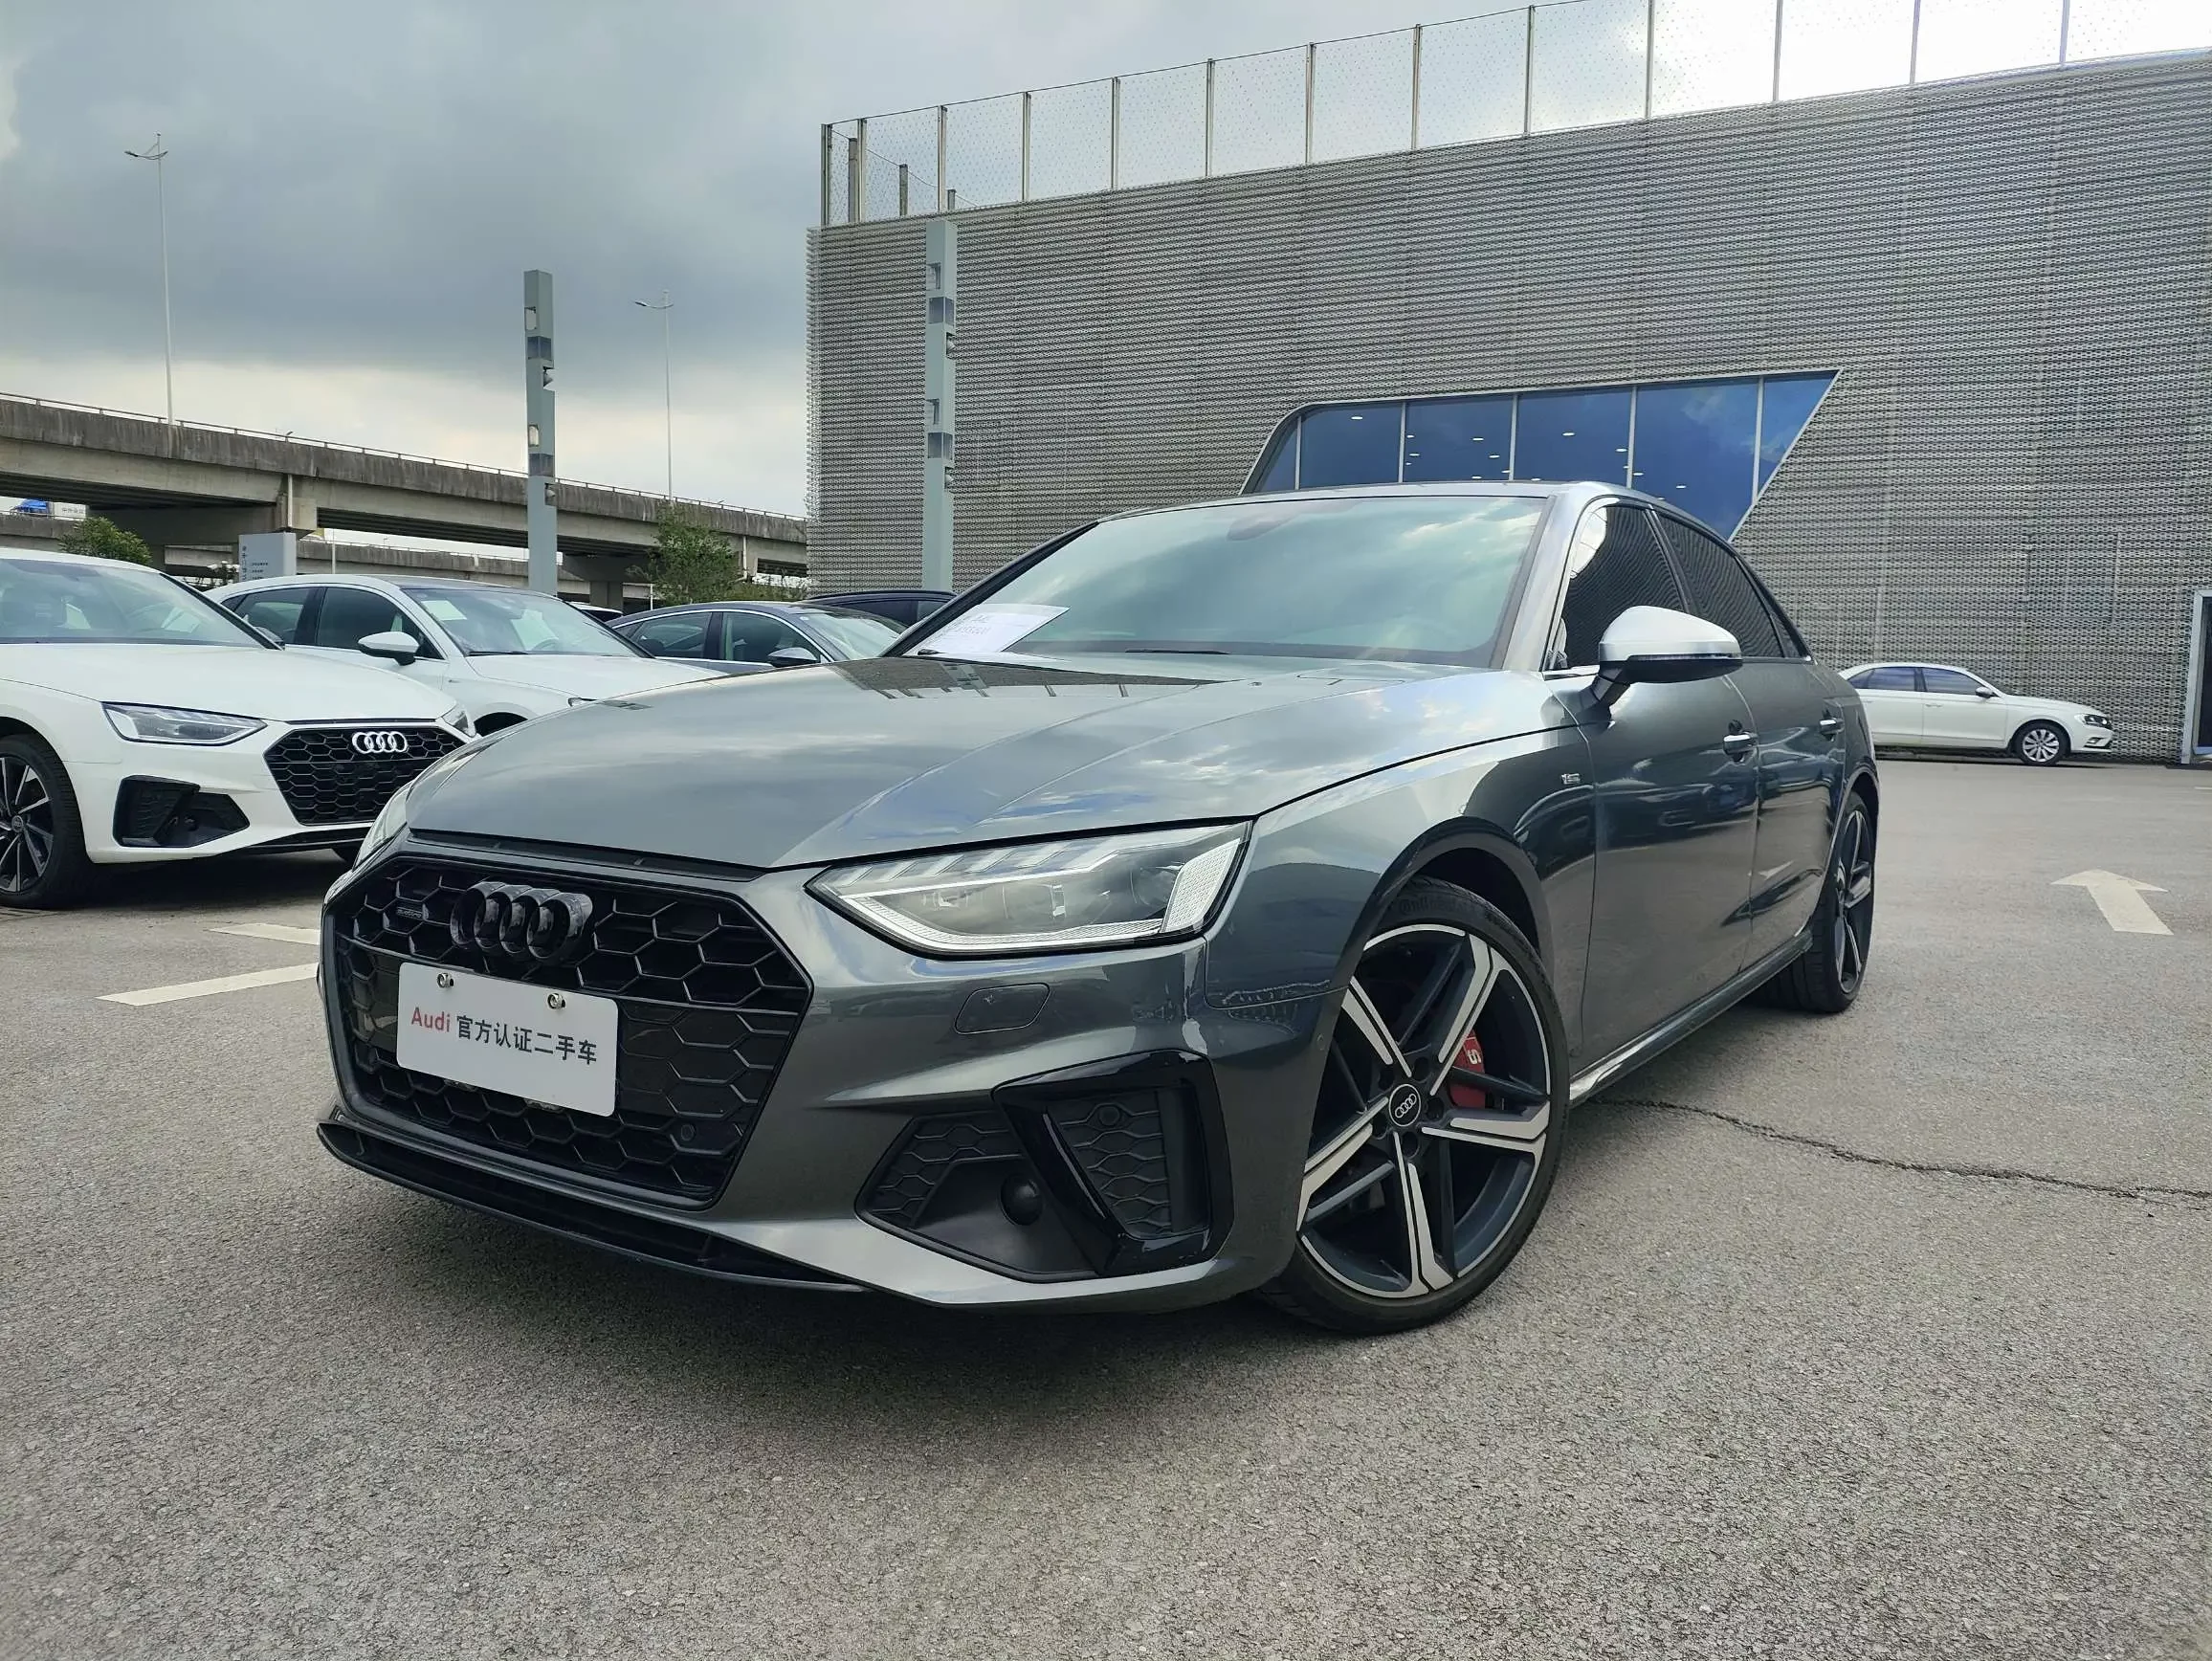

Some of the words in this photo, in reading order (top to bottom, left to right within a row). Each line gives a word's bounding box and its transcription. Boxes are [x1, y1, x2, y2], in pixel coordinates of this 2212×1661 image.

[411, 1007, 450, 1032] Audi
[456, 1015, 597, 1065] 官方认证二手车
